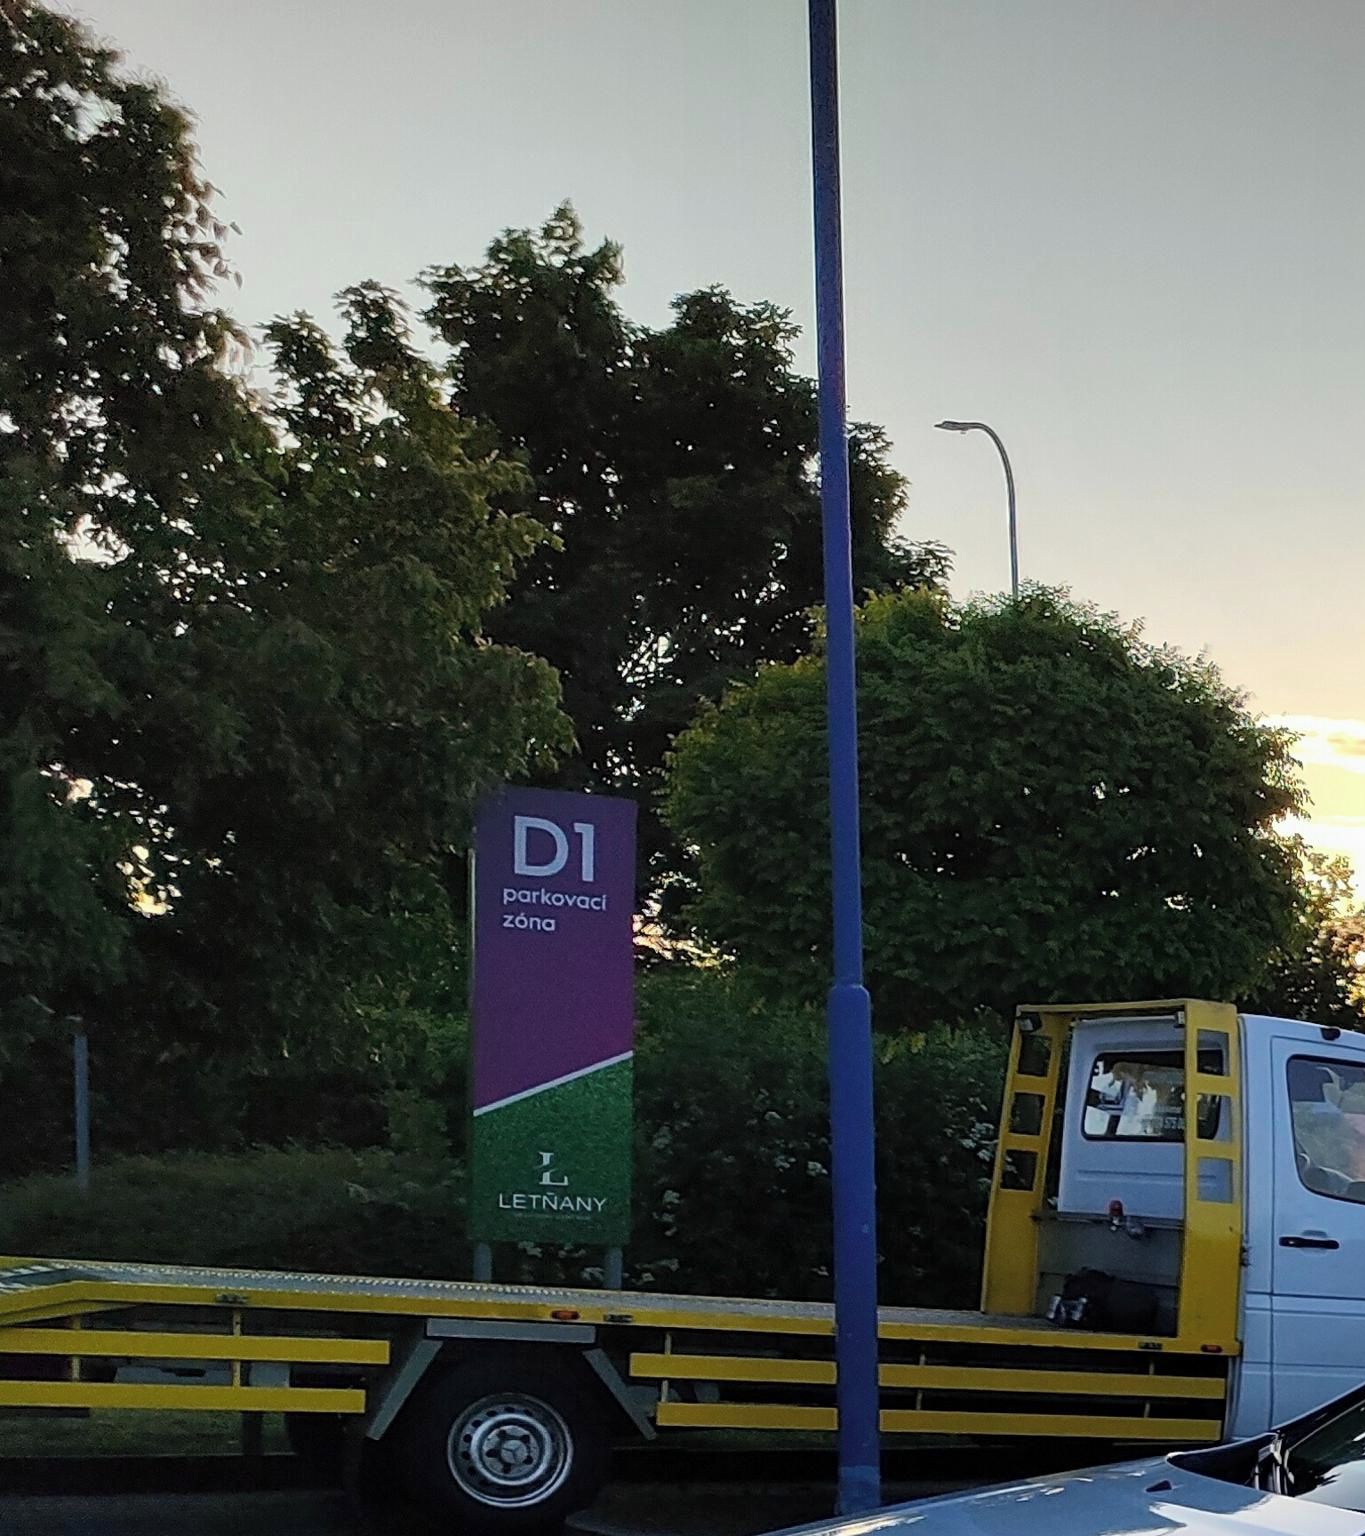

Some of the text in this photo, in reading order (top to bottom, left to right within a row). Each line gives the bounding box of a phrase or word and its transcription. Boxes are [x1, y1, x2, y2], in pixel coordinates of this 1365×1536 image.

[514, 815, 595, 882] D1
[503, 887, 607, 911] parkovací
[503, 912, 556, 931] zóna
[499, 1192, 607, 1212] LETŇANY
